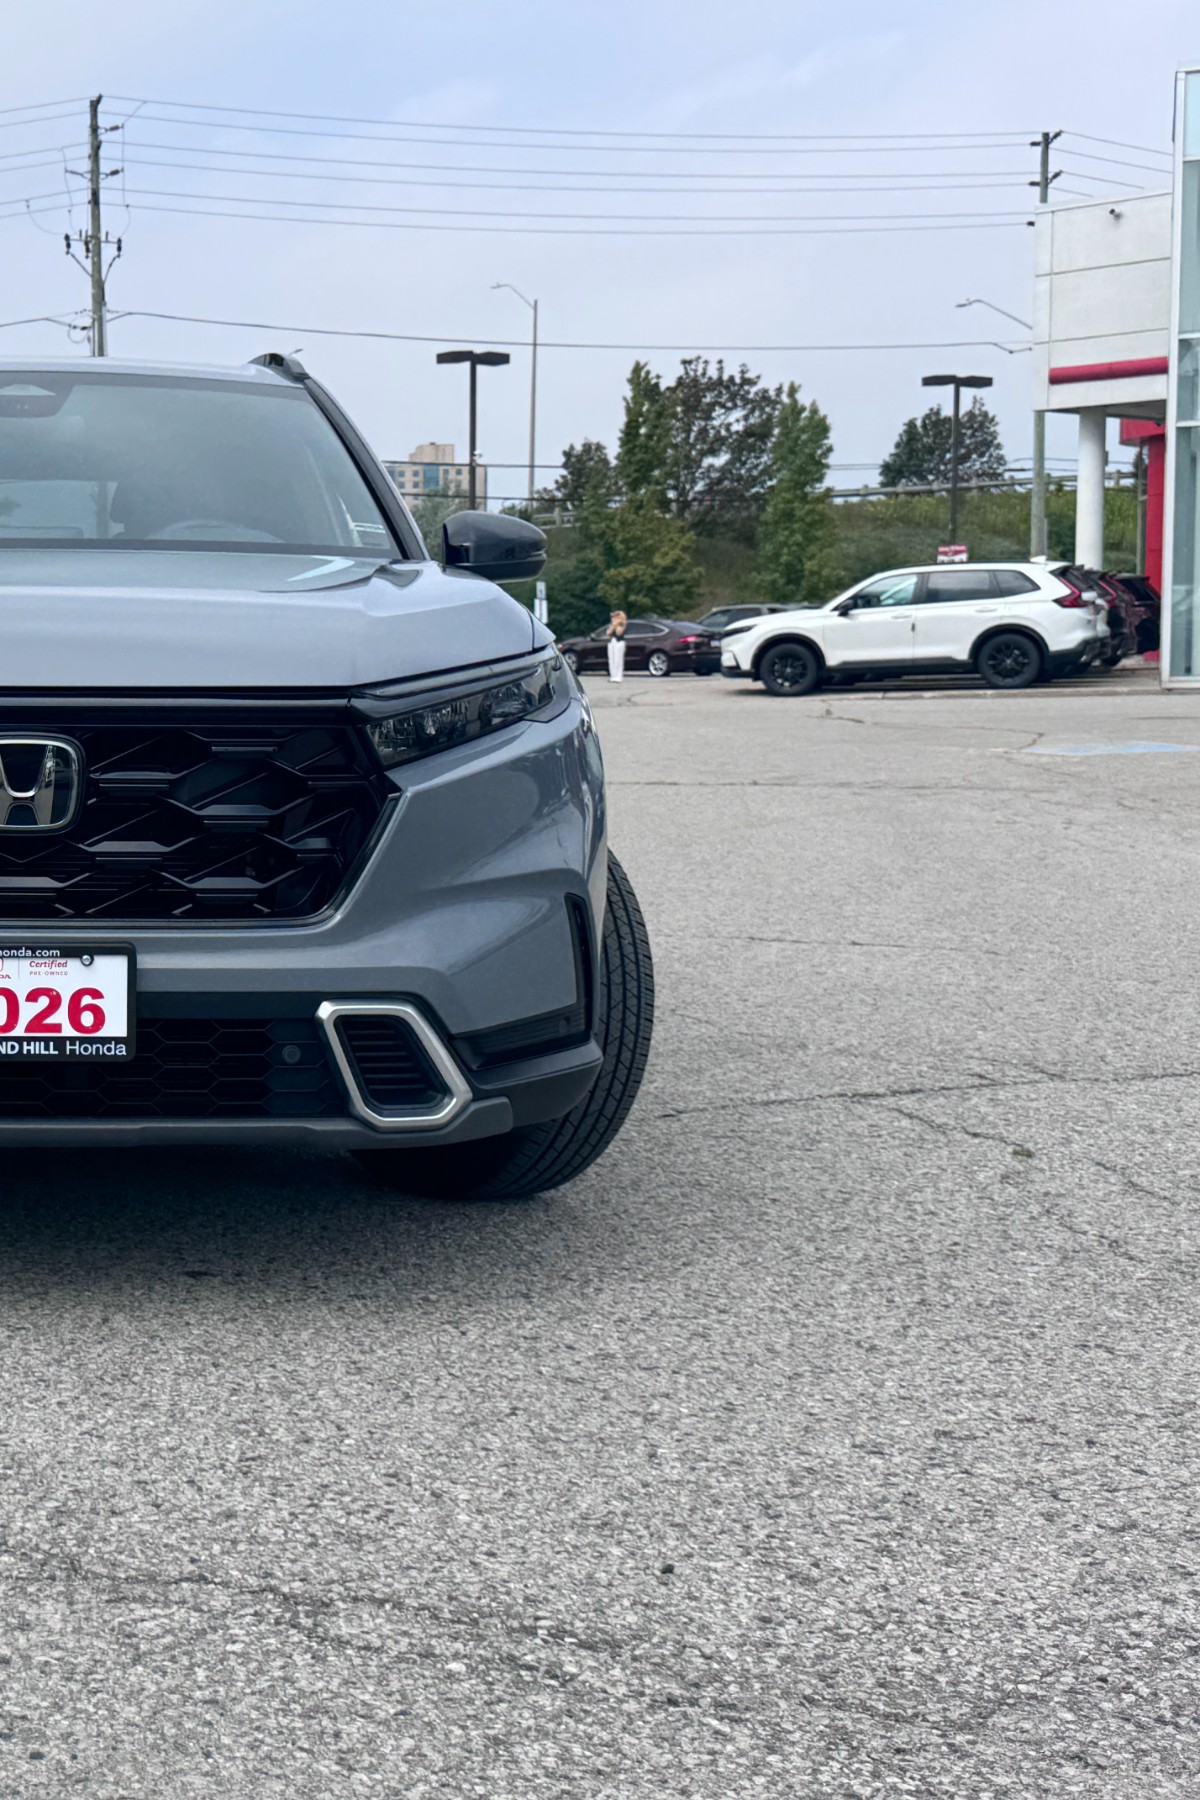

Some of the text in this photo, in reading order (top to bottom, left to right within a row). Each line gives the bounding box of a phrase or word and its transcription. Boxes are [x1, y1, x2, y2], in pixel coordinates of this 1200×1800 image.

[29, 959, 68, 969] Certified
[23, 1041, 59, 1055] HILL
[66, 1040, 127, 1056] Honda
